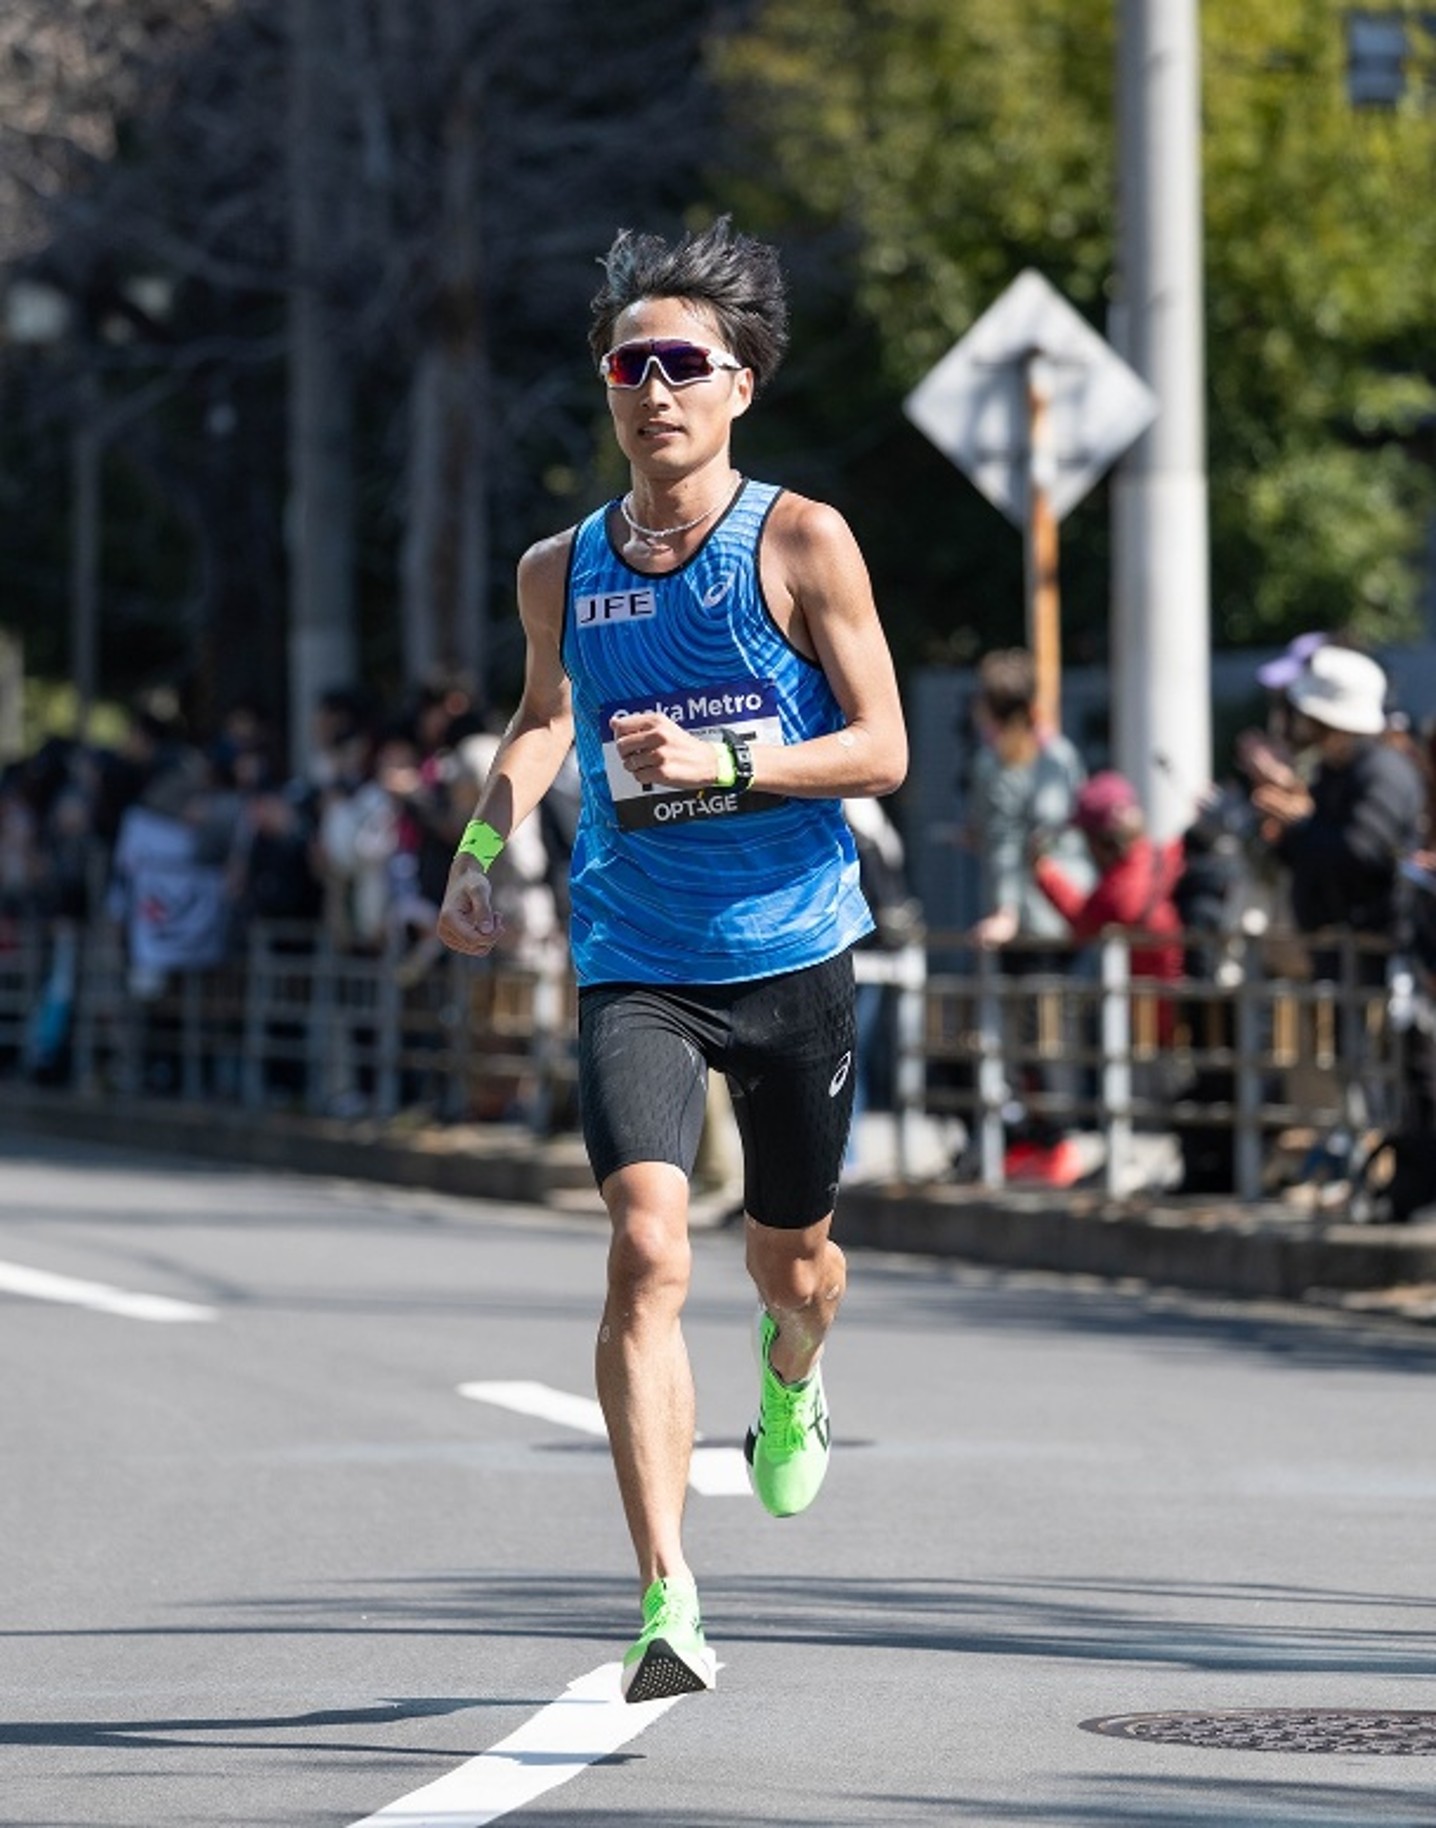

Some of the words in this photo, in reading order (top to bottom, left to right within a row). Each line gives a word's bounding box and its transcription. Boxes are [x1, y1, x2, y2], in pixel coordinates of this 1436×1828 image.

[580, 591, 653, 624] JFE
[687, 693, 762, 720] Metro
[653, 794, 738, 821] OPTAGE
